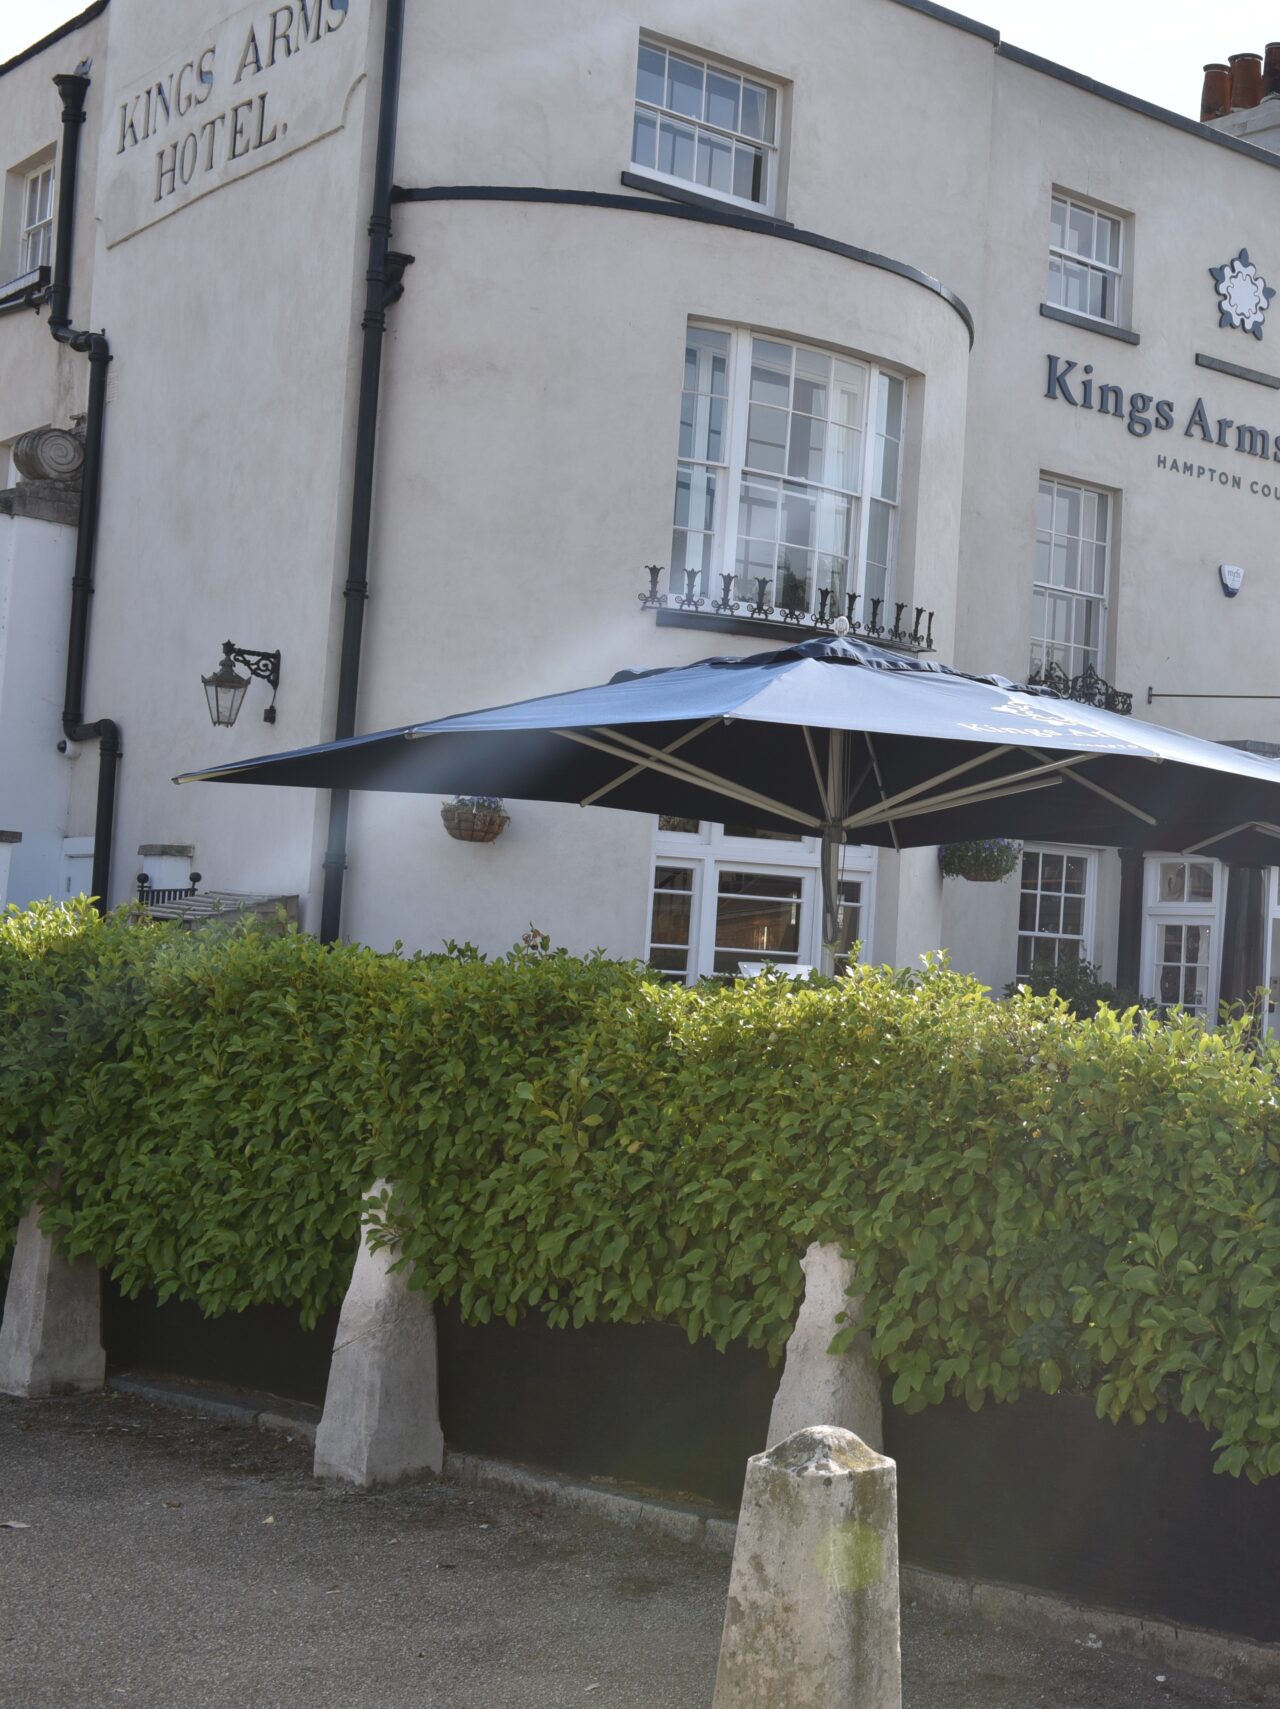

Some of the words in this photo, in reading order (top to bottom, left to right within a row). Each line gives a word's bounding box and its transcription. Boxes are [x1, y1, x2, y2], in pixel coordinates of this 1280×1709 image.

[117, 45, 216, 155] KINGS
[233, 0, 350, 85] ARMS
[154, 91, 288, 203] HOTEL.
[1044, 354, 1175, 438] Kings
[1157, 454, 1242, 490] HAMPTON
